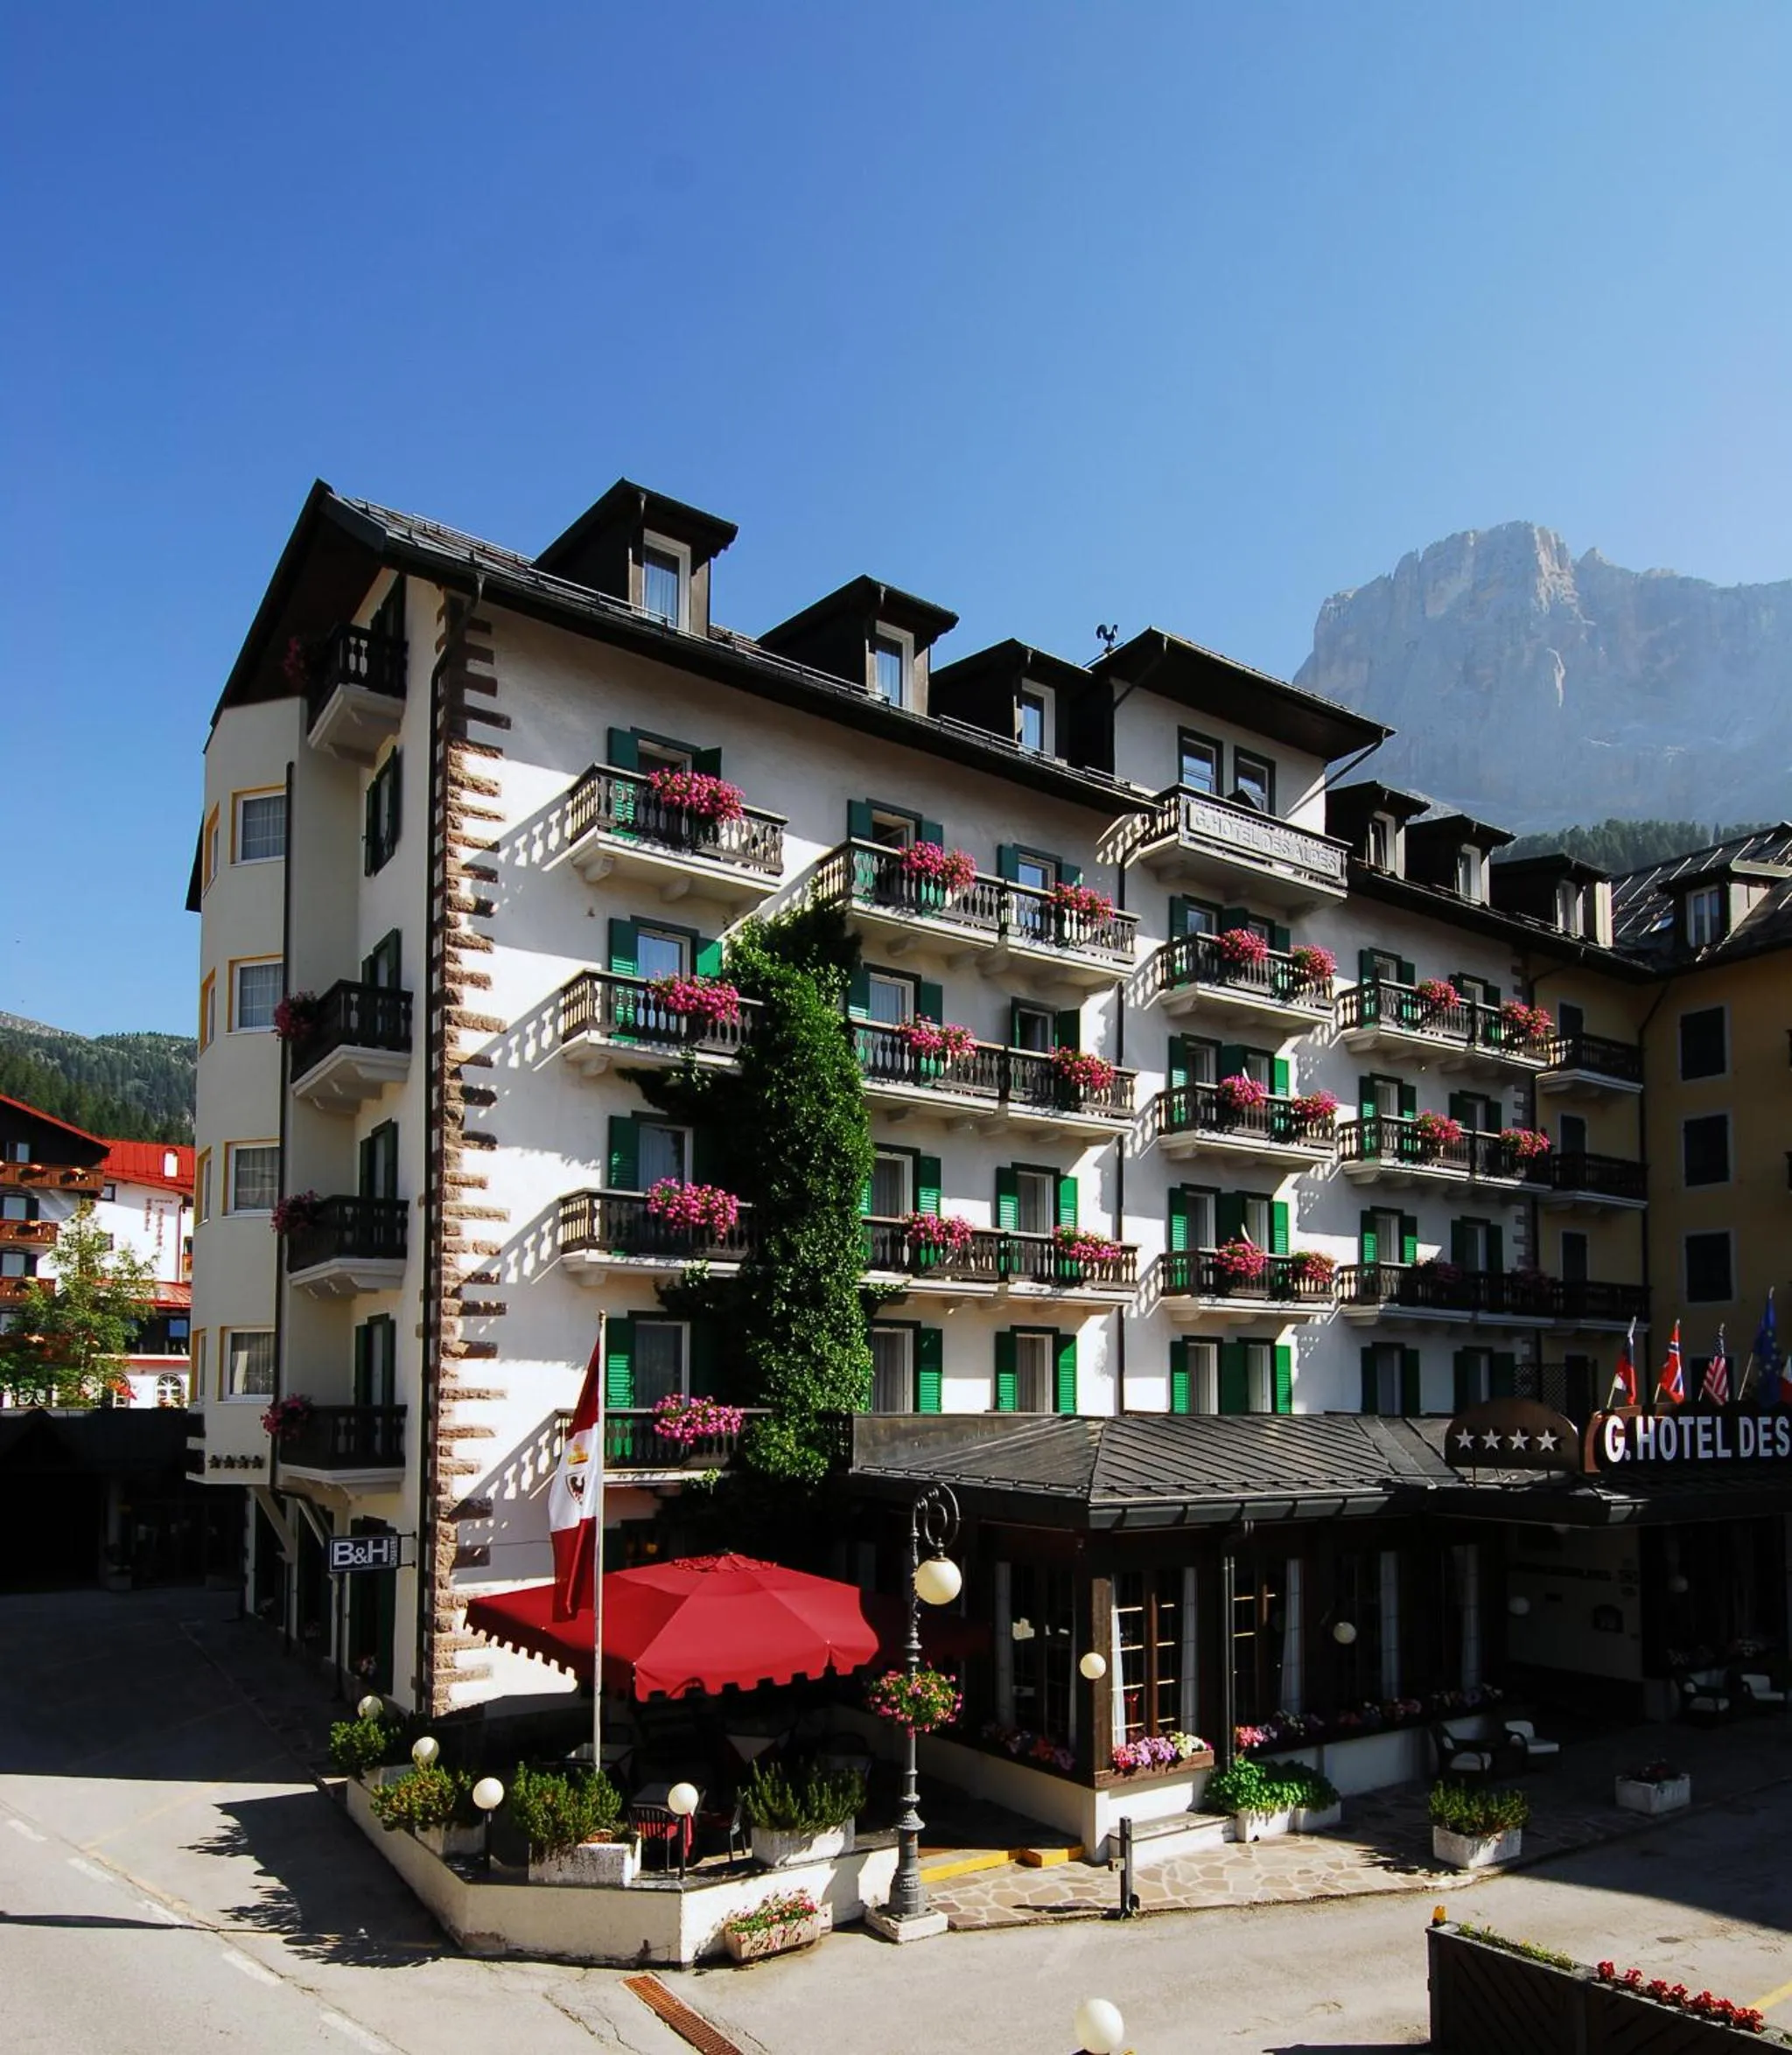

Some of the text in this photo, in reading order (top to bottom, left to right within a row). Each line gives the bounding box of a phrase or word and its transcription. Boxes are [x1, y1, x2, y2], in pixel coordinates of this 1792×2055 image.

[1263, 833, 1291, 856] DES
[1293, 843, 1338, 872] ALPES
[1739, 1415, 1790, 1457] DES
[333, 1540, 388, 1566] B&H
